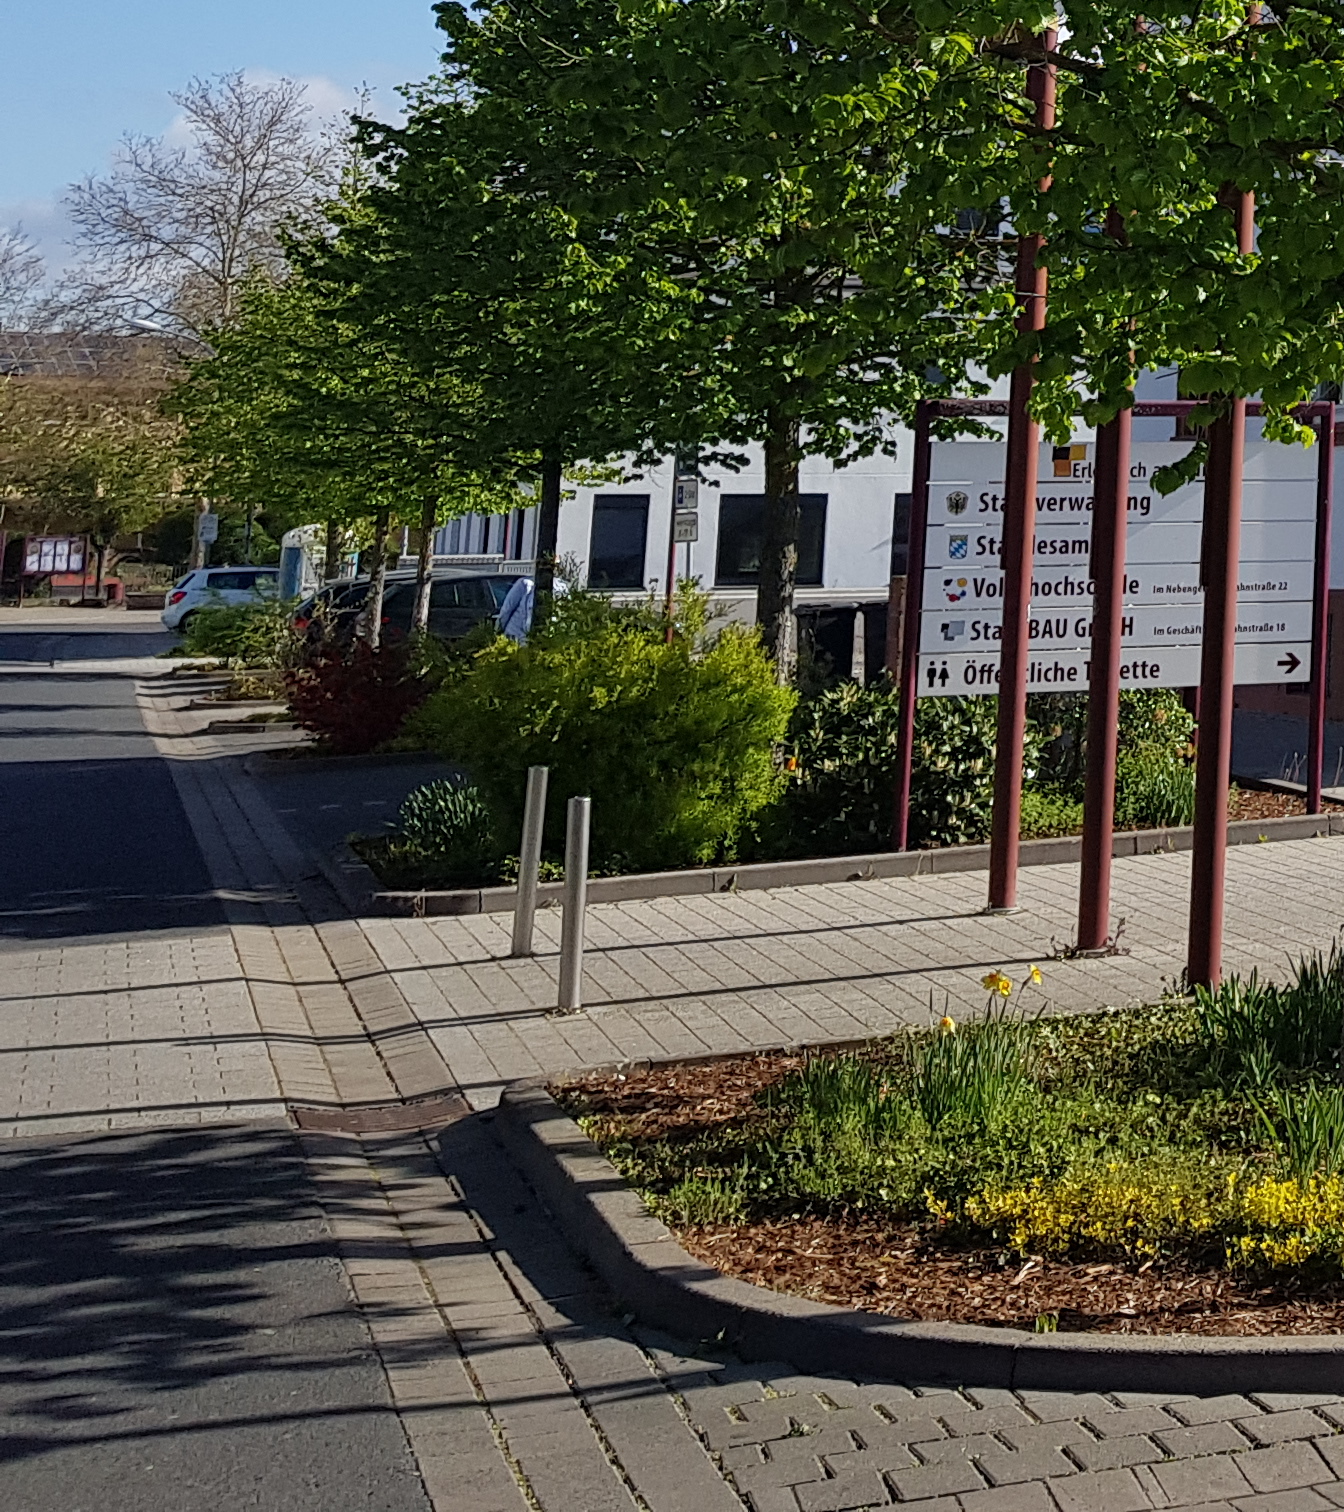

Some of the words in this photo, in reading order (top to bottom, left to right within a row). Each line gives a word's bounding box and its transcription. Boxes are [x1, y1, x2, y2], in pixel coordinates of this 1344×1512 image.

[1072, 461, 1147, 479] Erlch
[978, 492, 1151, 516] Staverwang
[975, 534, 1089, 556] Staesam
[973, 574, 1140, 598] Volhochscle
[1278, 581, 1288, 591] 22
[1074, 616, 1134, 638] GH
[963, 659, 1078, 686] Öffeliche
[1083, 660, 1161, 680] Tette
